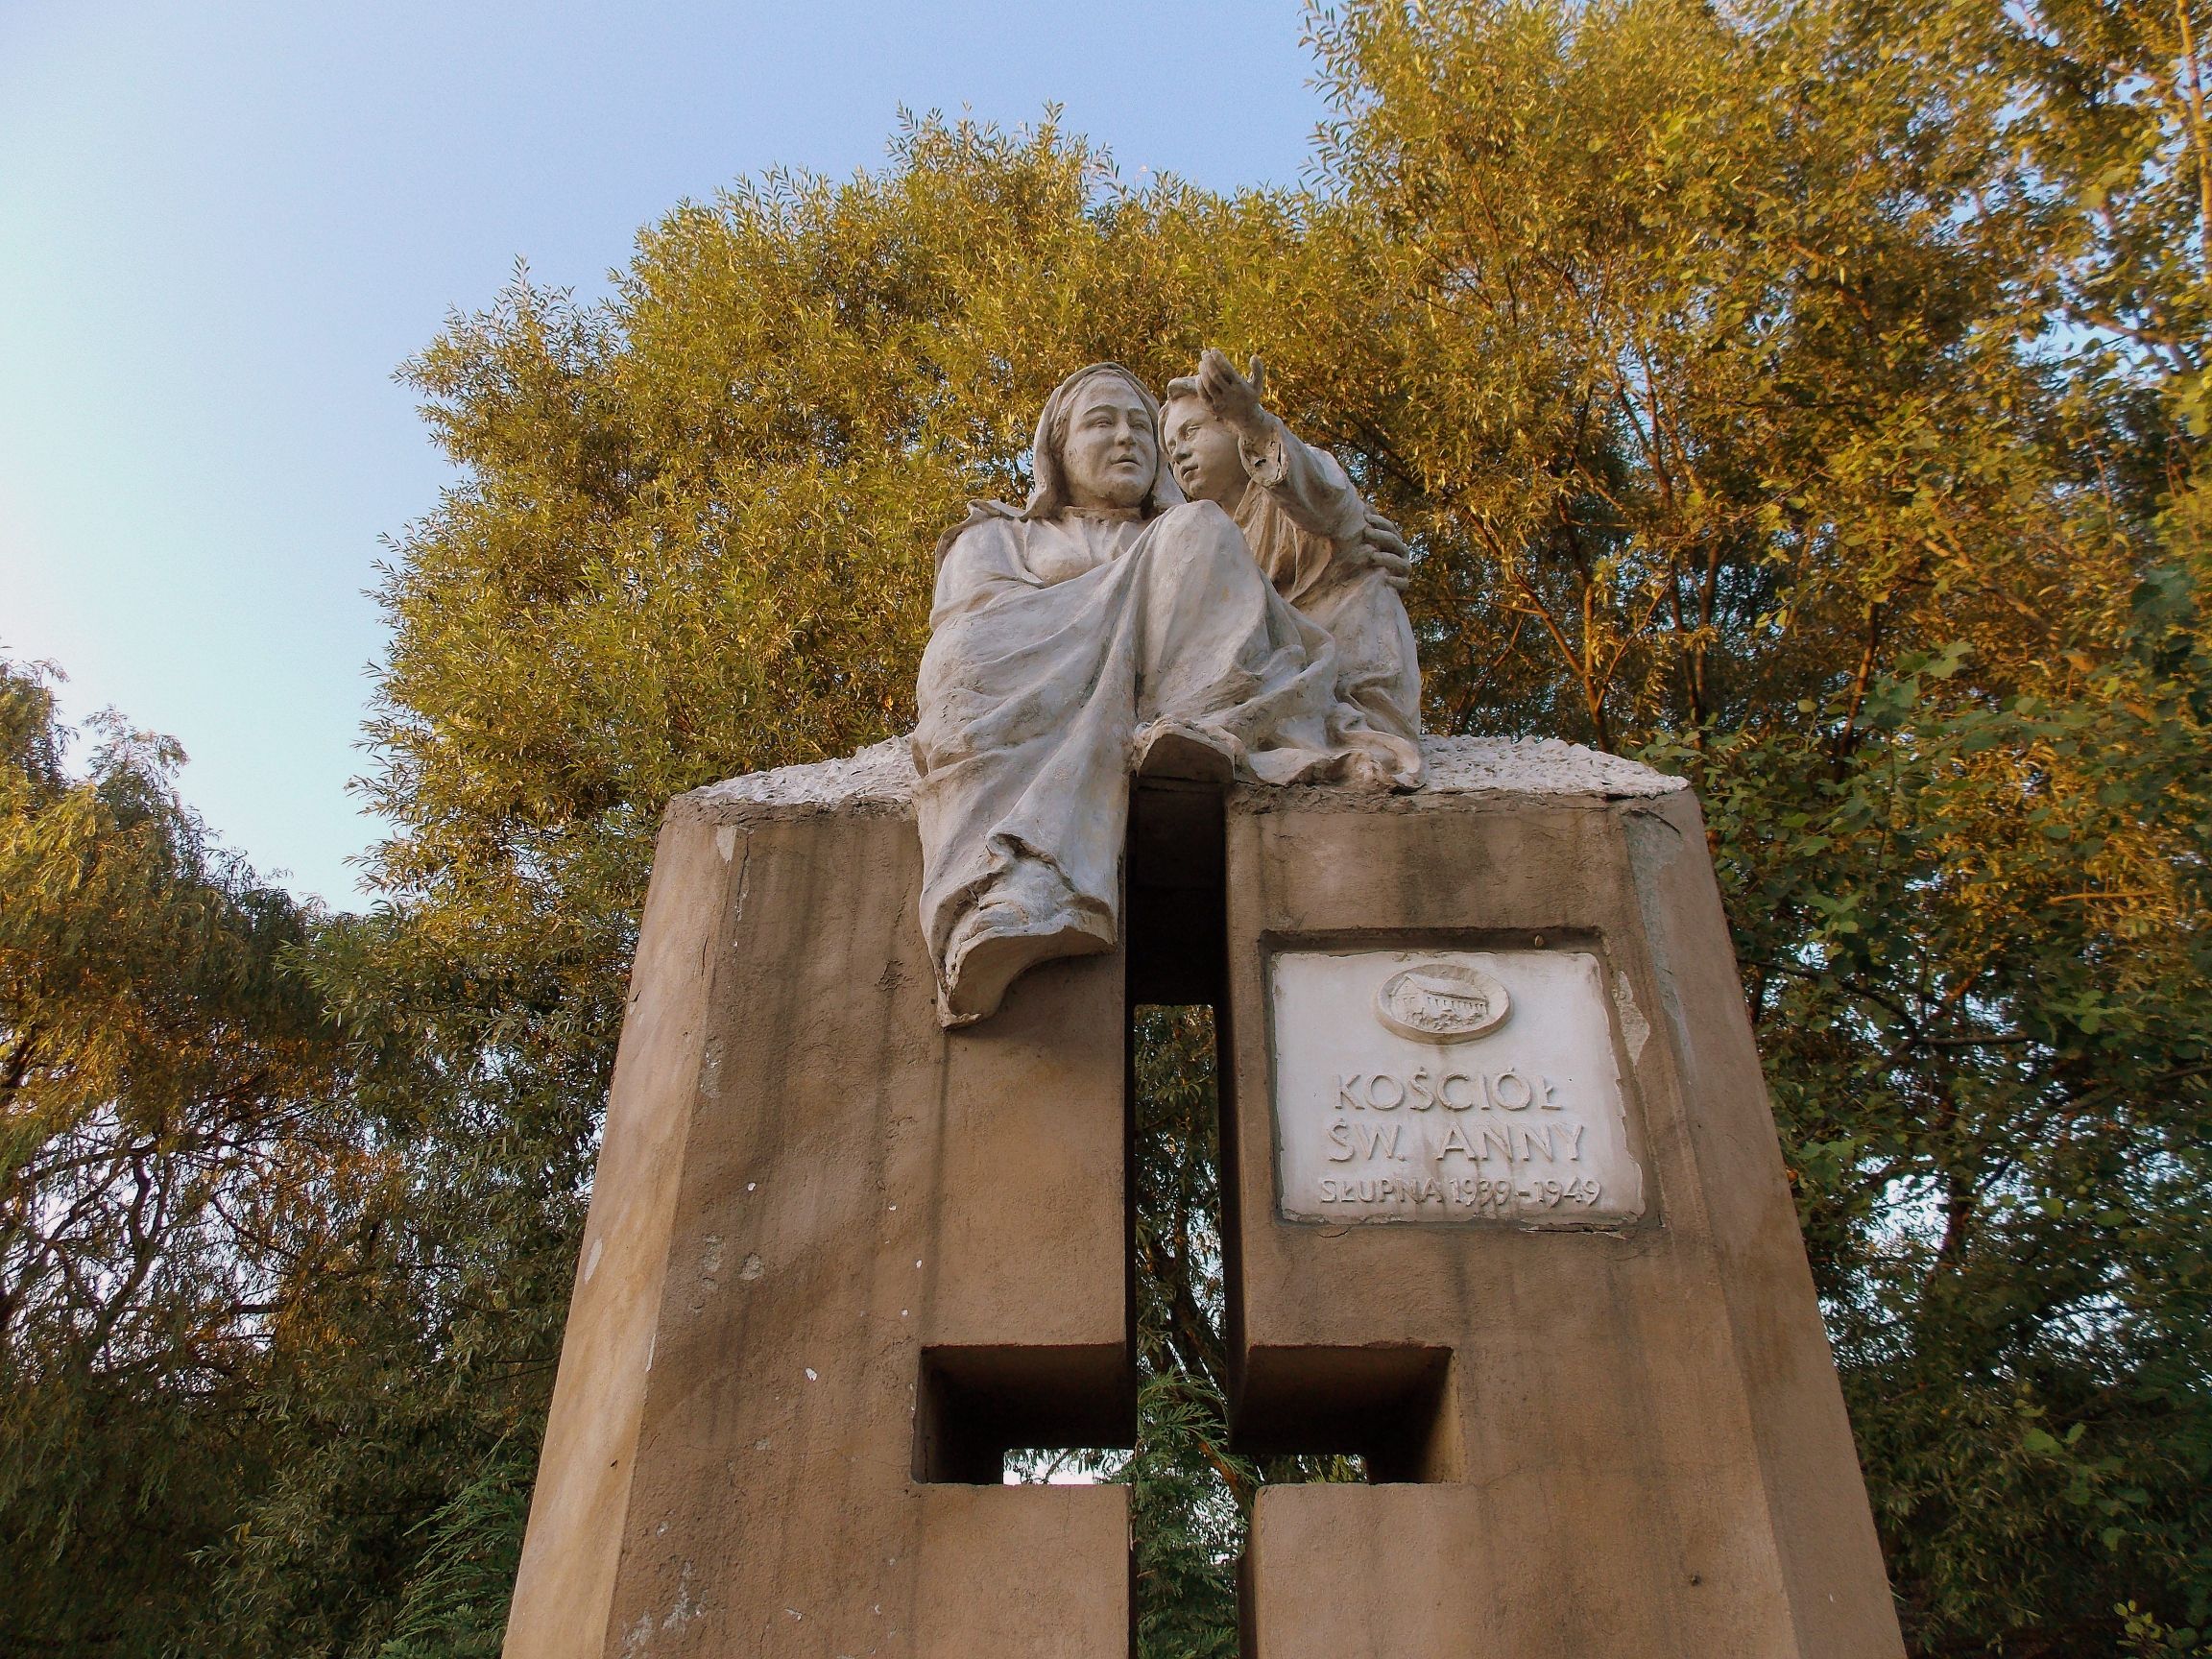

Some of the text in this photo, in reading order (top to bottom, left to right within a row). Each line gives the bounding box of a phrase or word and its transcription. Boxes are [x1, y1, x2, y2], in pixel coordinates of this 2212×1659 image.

[1334, 1066, 1563, 1112] KOŚCIÓŁ
[1327, 1118, 1585, 1163] ŚW. ANNY
[1319, 1177, 1443, 1205] SŁUPNA
